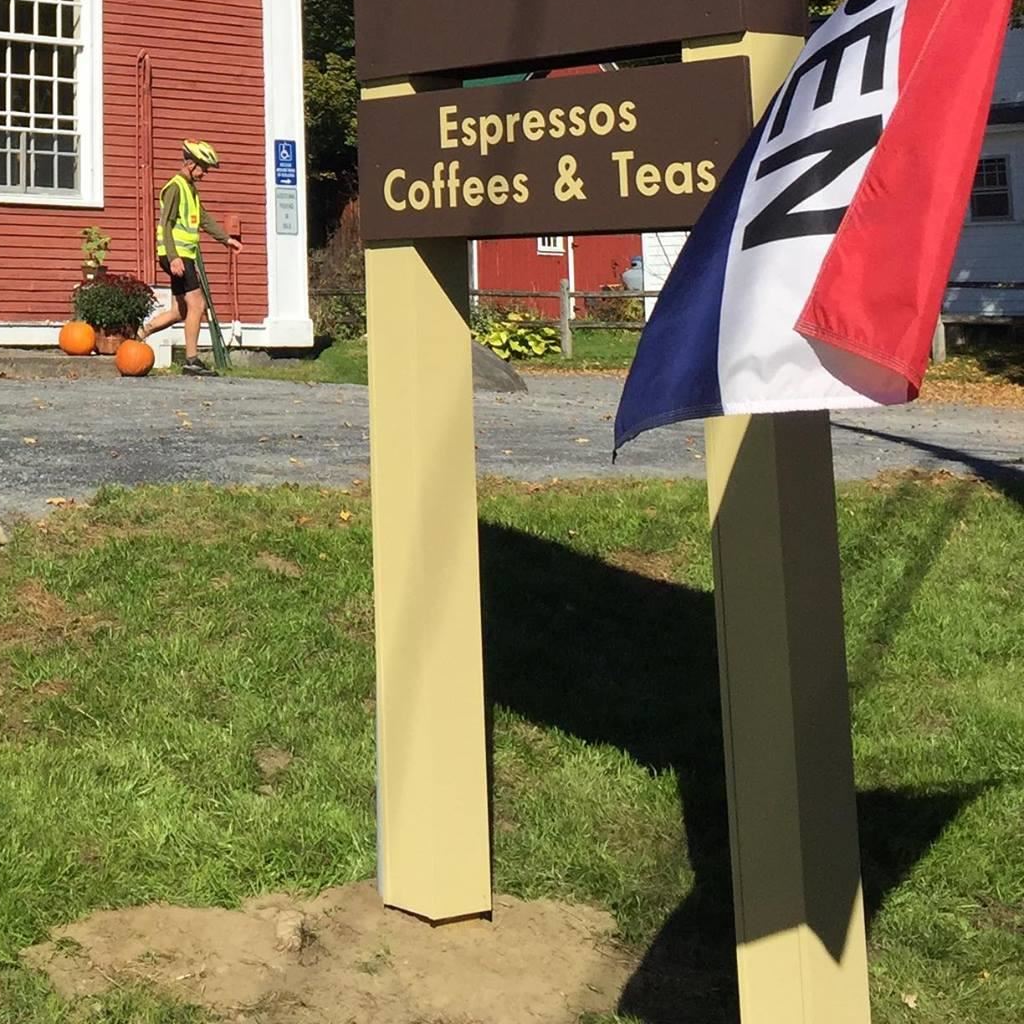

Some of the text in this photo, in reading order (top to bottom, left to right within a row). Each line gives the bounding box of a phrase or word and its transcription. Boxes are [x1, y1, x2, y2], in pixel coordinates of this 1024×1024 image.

[439, 99, 638, 157] Espressos
[383, 150, 717, 212] Coffees & Teas
